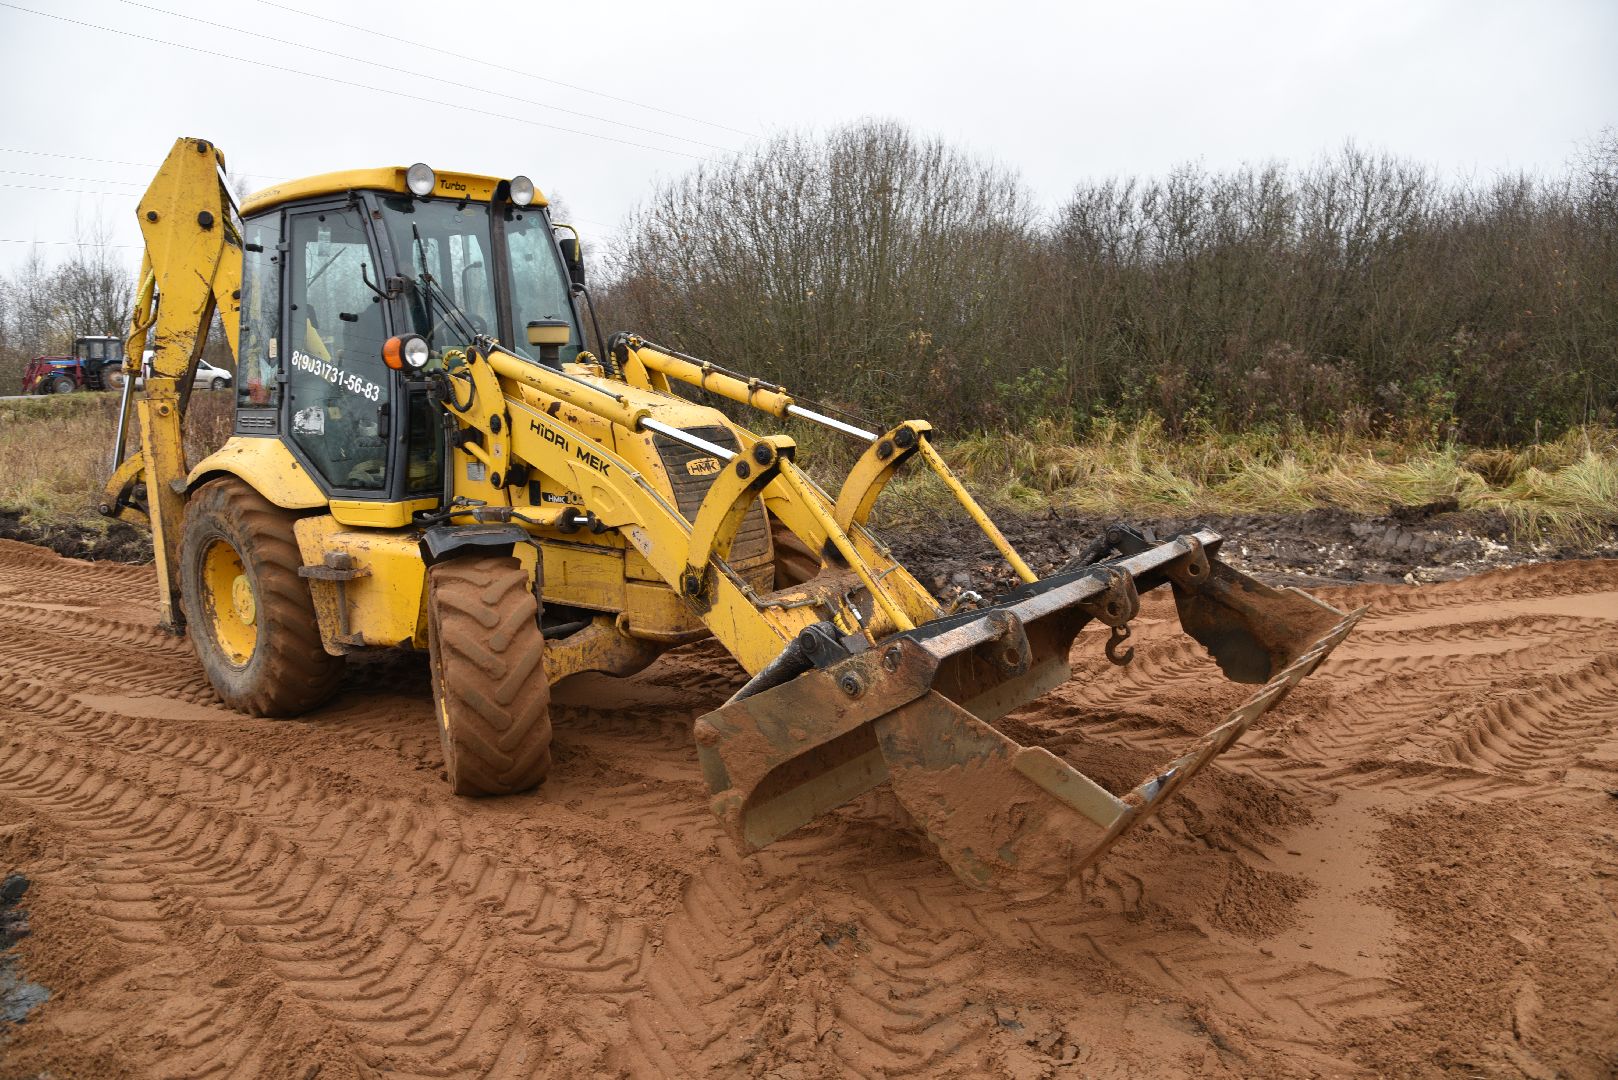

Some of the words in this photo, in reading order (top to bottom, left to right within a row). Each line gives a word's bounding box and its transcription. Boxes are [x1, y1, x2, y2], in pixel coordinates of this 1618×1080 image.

[440, 179, 467, 192] Turbo
[690, 459, 718, 474] HMK
[548, 494, 566, 504] HMK
